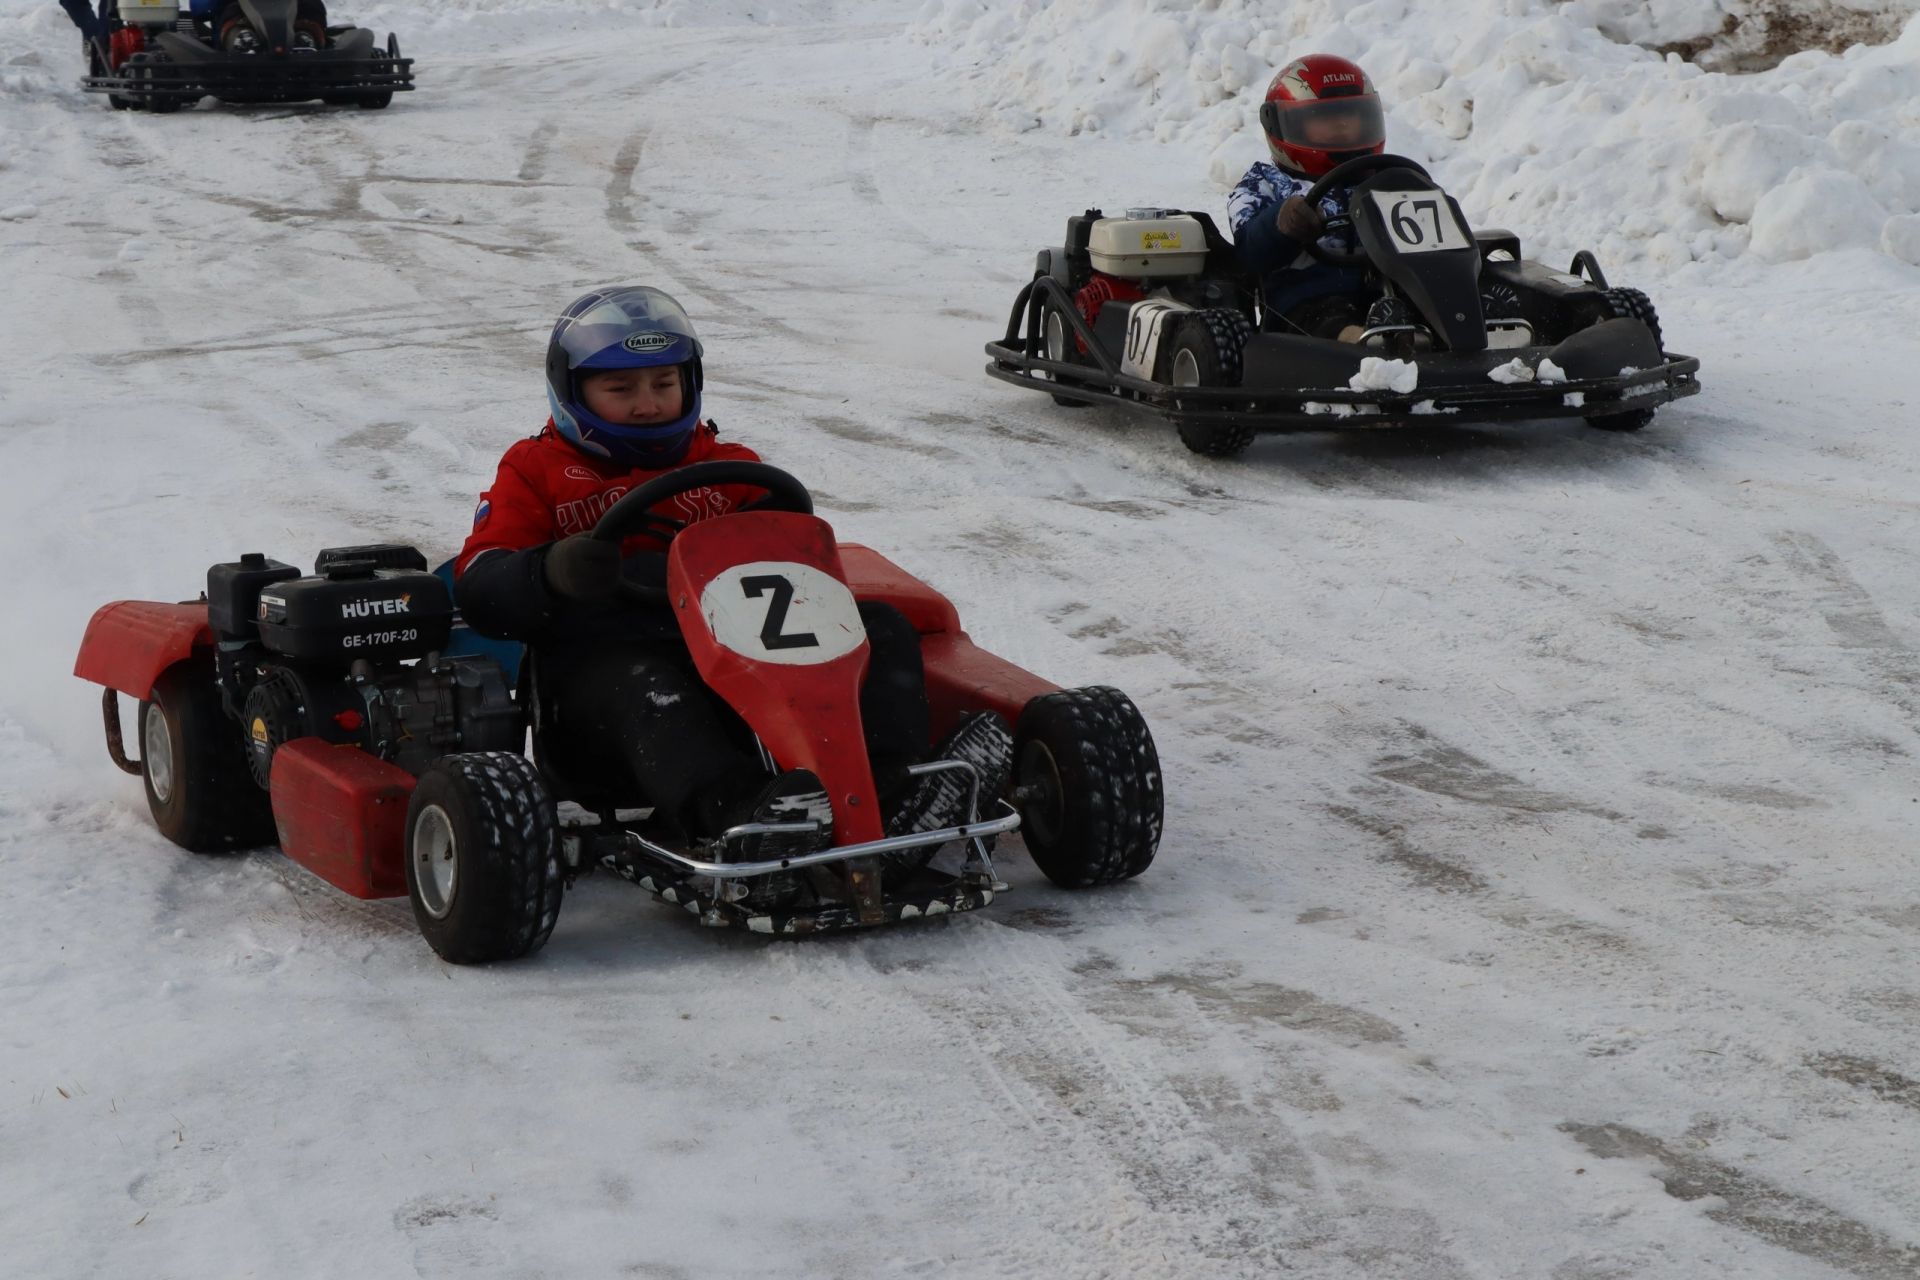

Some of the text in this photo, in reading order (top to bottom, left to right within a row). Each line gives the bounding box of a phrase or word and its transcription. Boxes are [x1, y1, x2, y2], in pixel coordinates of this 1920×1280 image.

[1322, 73, 1355, 84] ATLANT
[1391, 200, 1443, 245] 67
[629, 337, 665, 347] FALCON
[341, 598, 410, 618] HÜTER
[740, 574, 820, 650] 2
[342, 628, 418, 648] GE-170F-20
